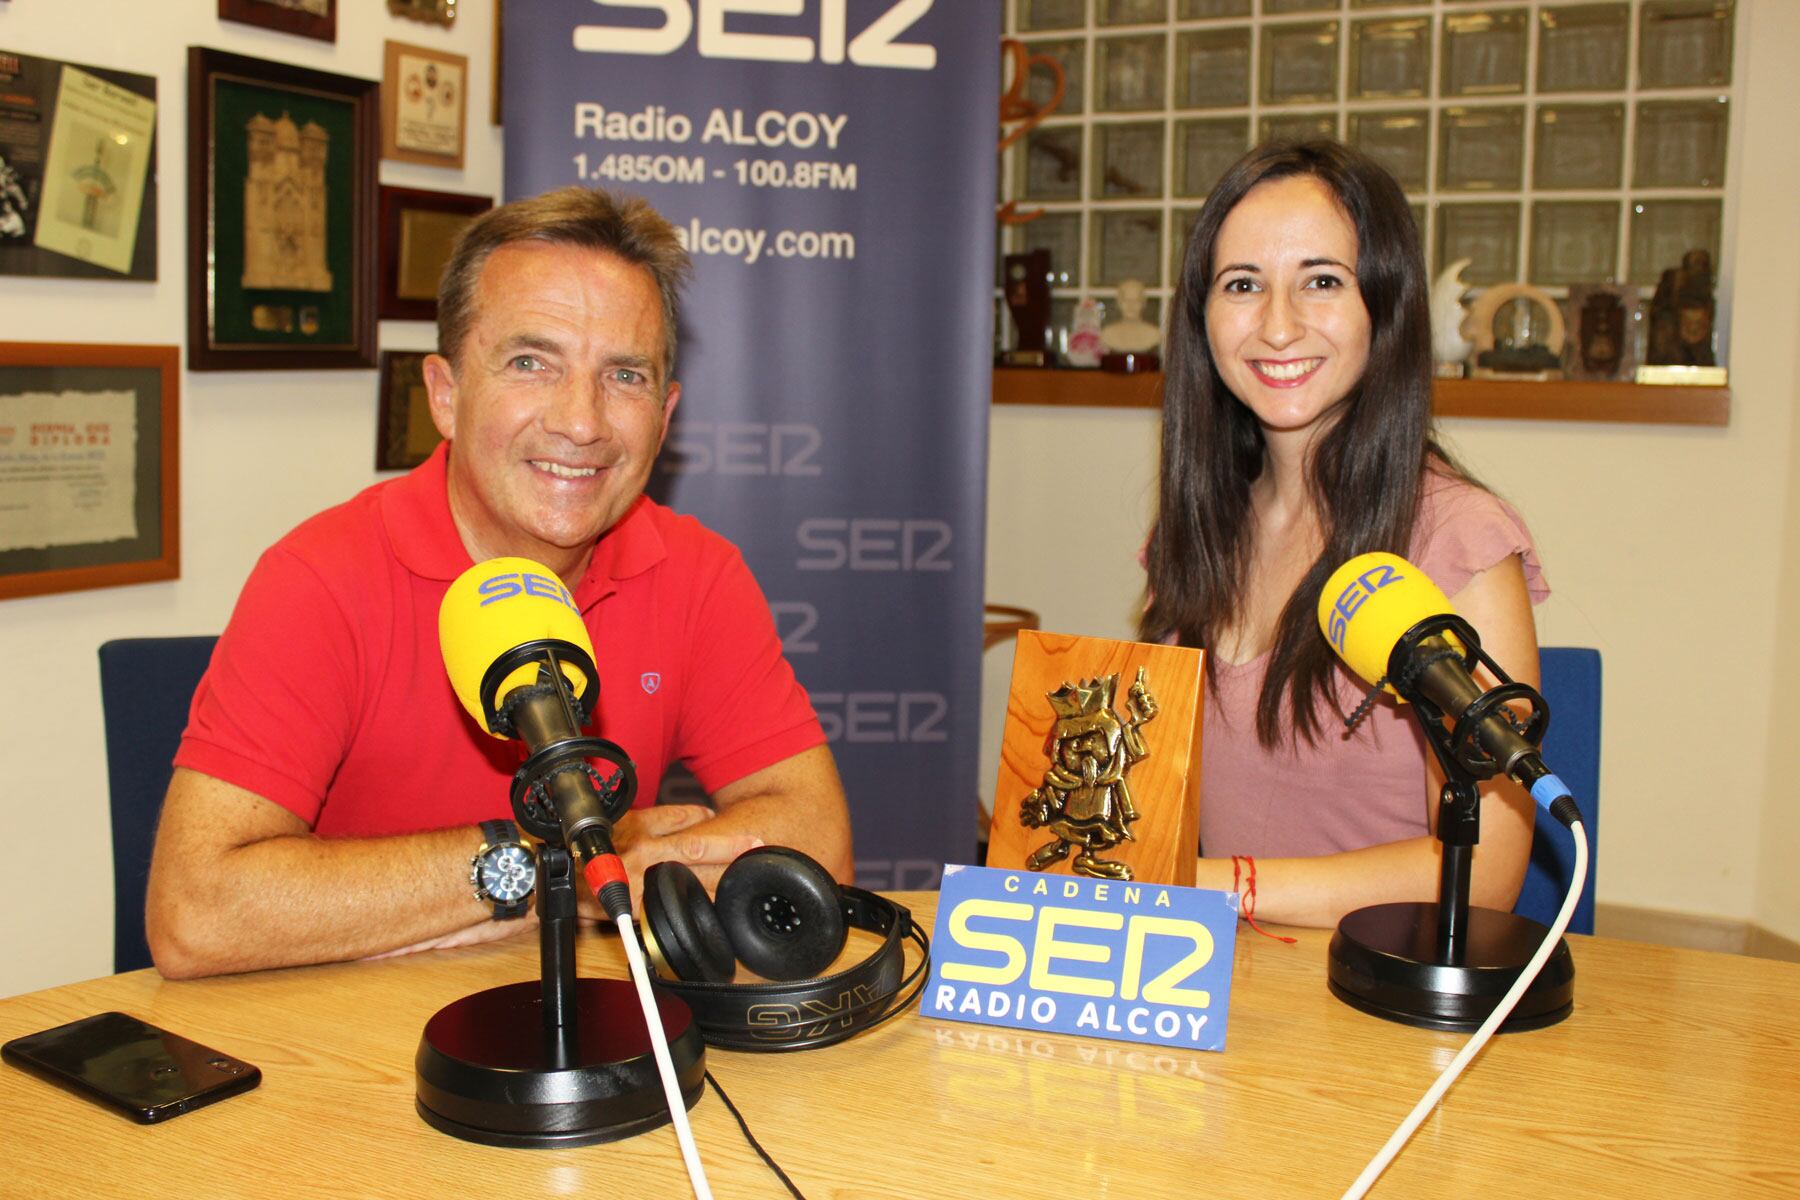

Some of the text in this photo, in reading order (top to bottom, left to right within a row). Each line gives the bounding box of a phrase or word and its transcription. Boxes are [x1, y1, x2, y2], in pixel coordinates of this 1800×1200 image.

[574, 103, 848, 148] Radio ALCOY
[734, 159, 857, 190] 100.8FM
[797, 519, 953, 571] SER
[1328, 565, 1404, 654] SER
[1004, 875, 1171, 907] CADENA
[940, 898, 1214, 1009] SER
[935, 985, 1209, 1041] RADIO ALCOY
